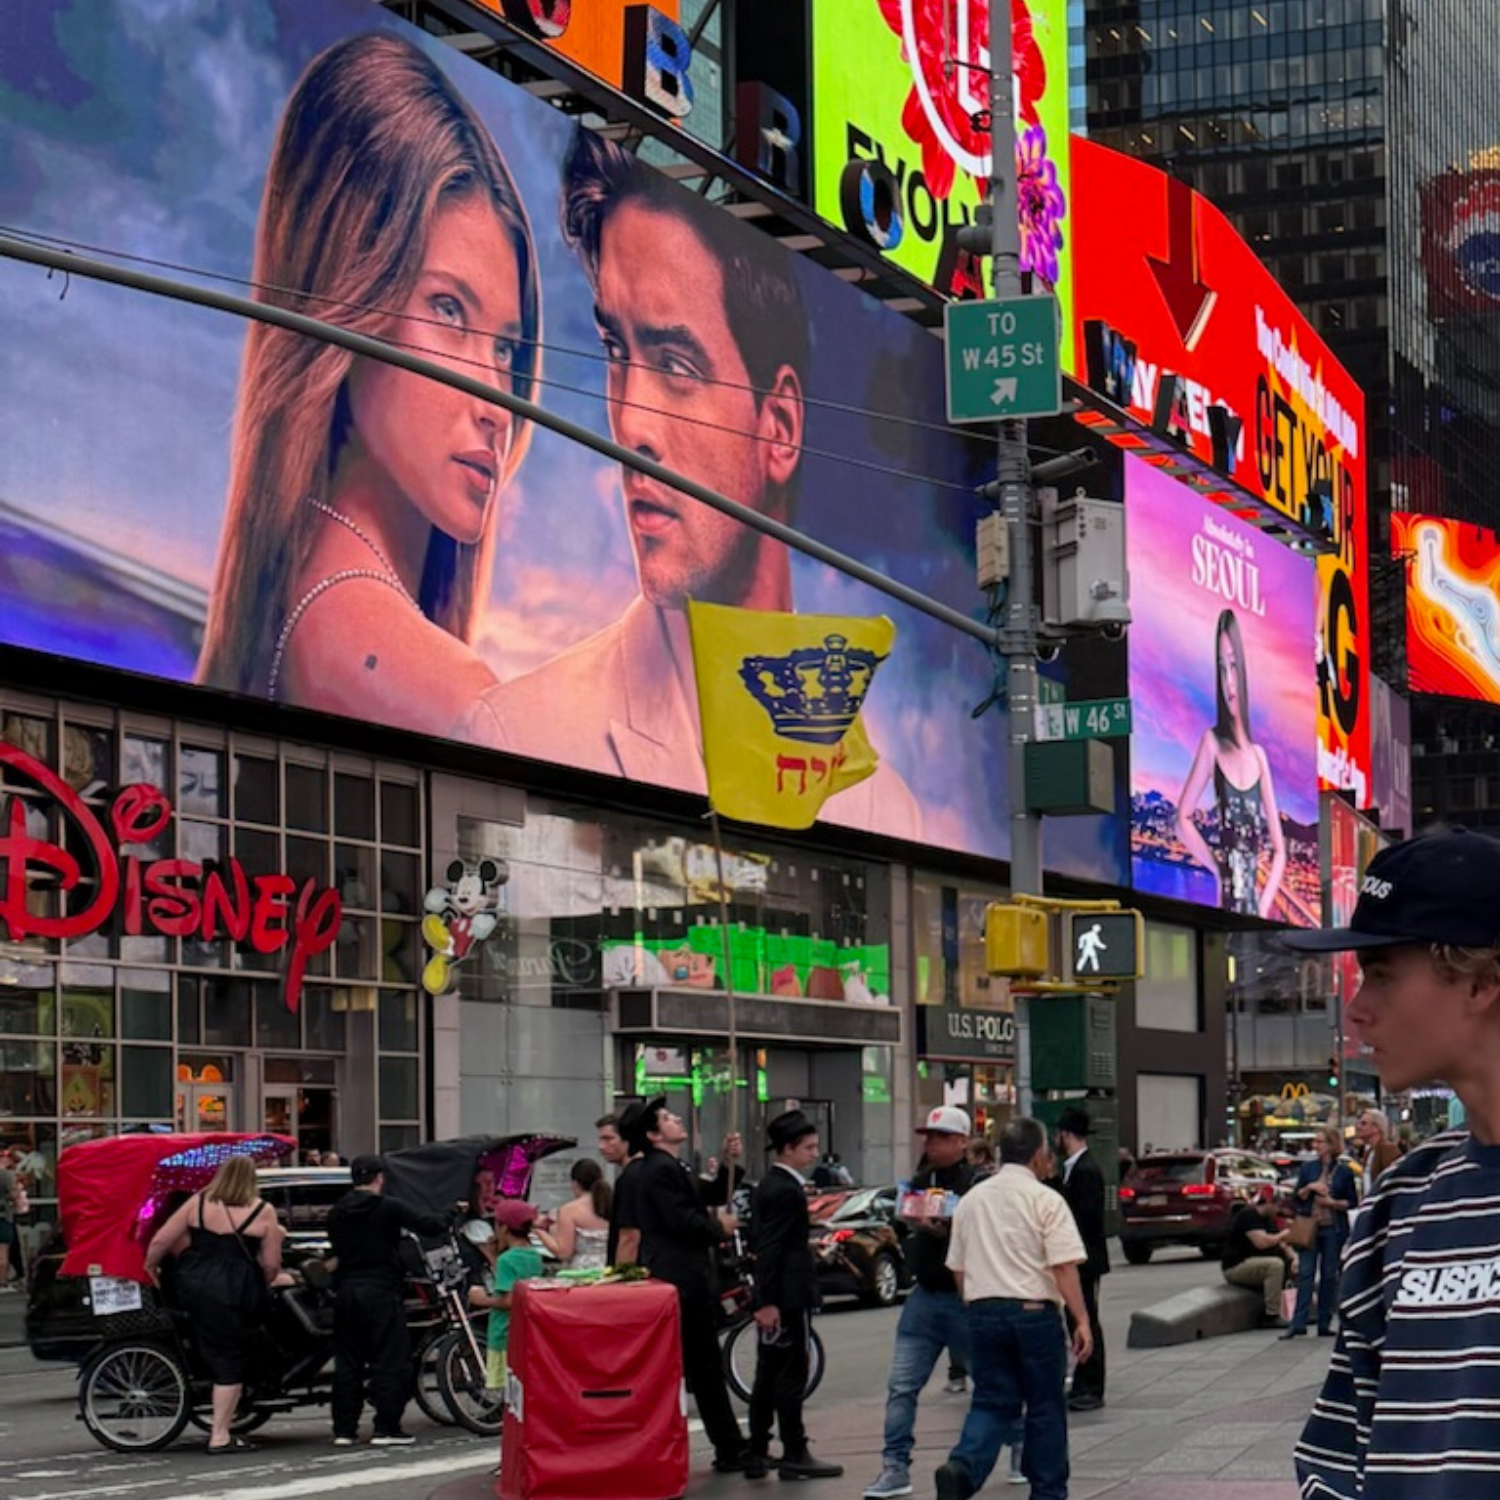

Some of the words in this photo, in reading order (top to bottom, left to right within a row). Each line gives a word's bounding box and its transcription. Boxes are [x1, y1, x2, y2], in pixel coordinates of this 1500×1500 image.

[986, 312, 1016, 336] TO
[963, 348, 980, 371] W
[984, 345, 1016, 368] 45
[1021, 342, 1044, 366] St
[1256, 373, 1298, 516] GET
[1192, 532, 1266, 617] SEOUL
[1065, 706, 1080, 735] W
[1086, 705, 1110, 733] 46
[947, 1012, 973, 1039] U.S.
[975, 1014, 1014, 1041] POLO
